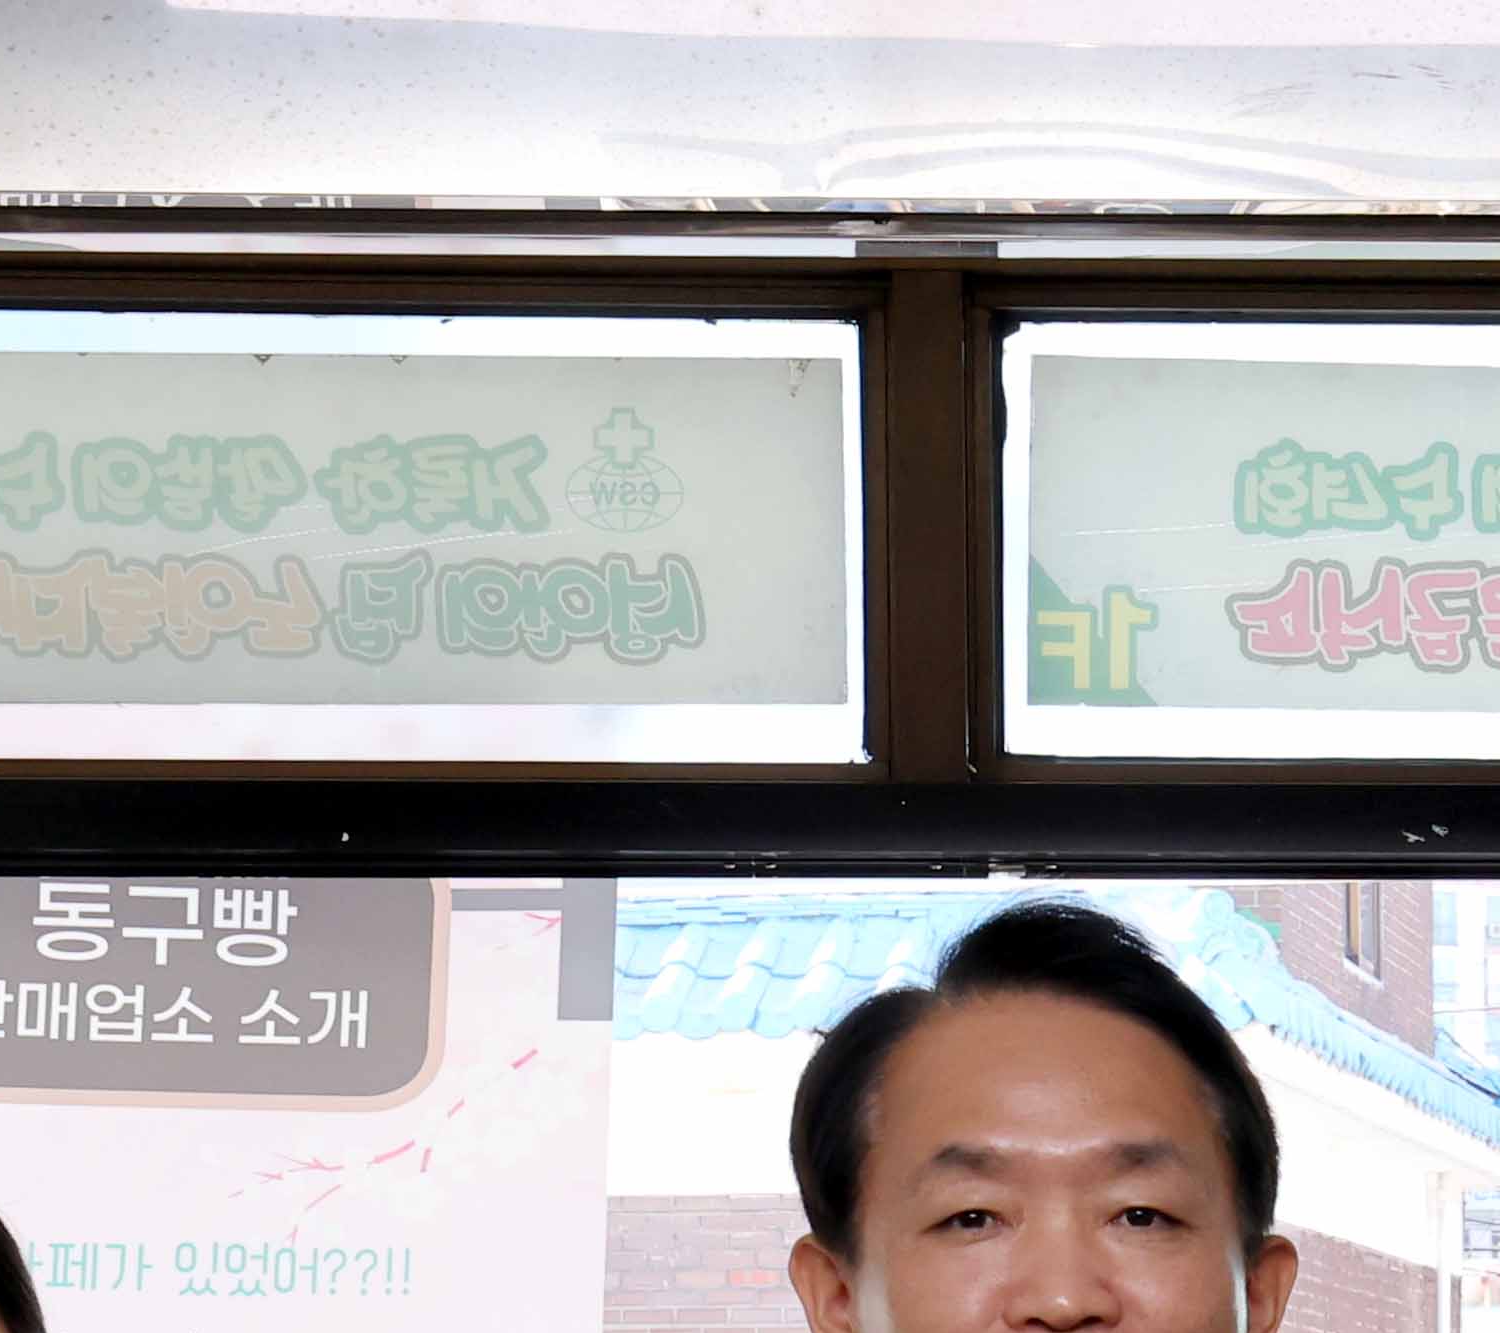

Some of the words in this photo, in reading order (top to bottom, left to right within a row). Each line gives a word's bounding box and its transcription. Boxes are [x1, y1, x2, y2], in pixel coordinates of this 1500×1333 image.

[32, 880, 299, 967] 동구빵
[238, 987, 370, 1049] 소개
[173, 1240, 413, 1297] 있었어??!!
